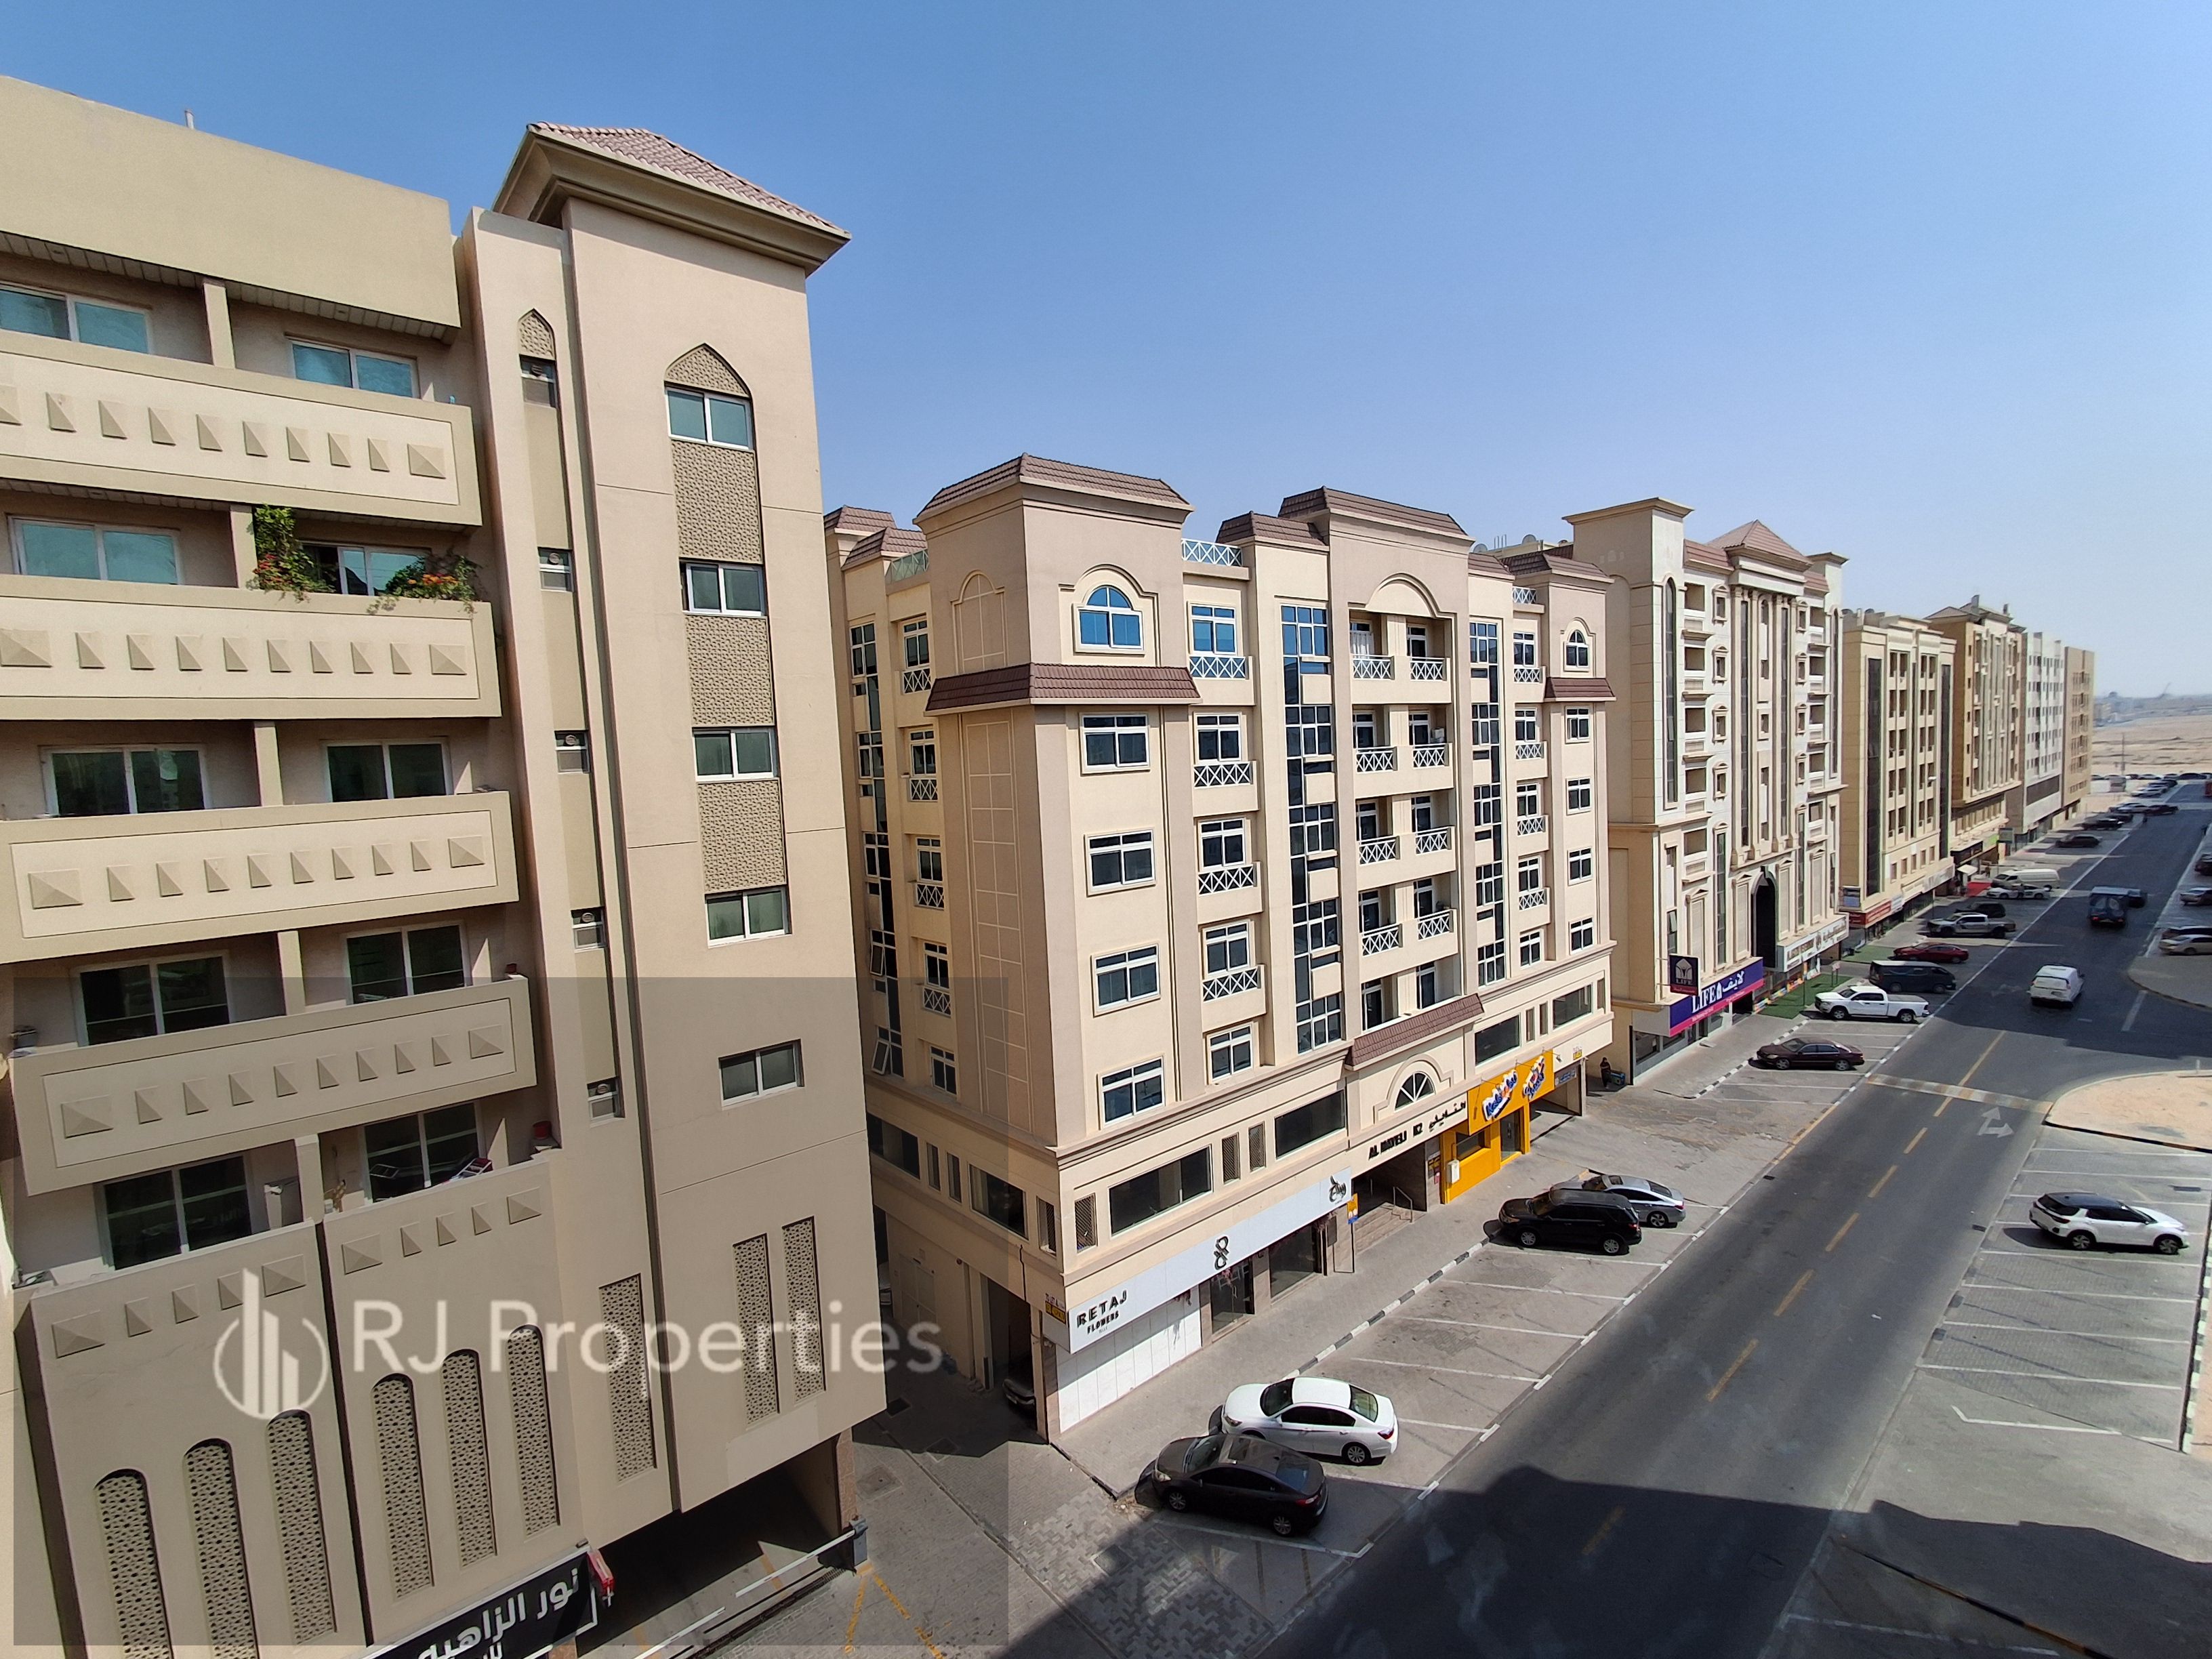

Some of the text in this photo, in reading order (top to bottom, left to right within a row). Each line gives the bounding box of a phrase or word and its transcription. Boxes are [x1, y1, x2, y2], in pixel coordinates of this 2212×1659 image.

[1676, 978, 1692, 986] LIFE
[1692, 984, 1717, 1013] LIFE
[1368, 1144, 1379, 1160] AL
[1077, 1290, 1127, 1328] RETAJ
[1087, 1311, 1119, 1334] FLOWERS
[537, 1567, 579, 1620] نور
